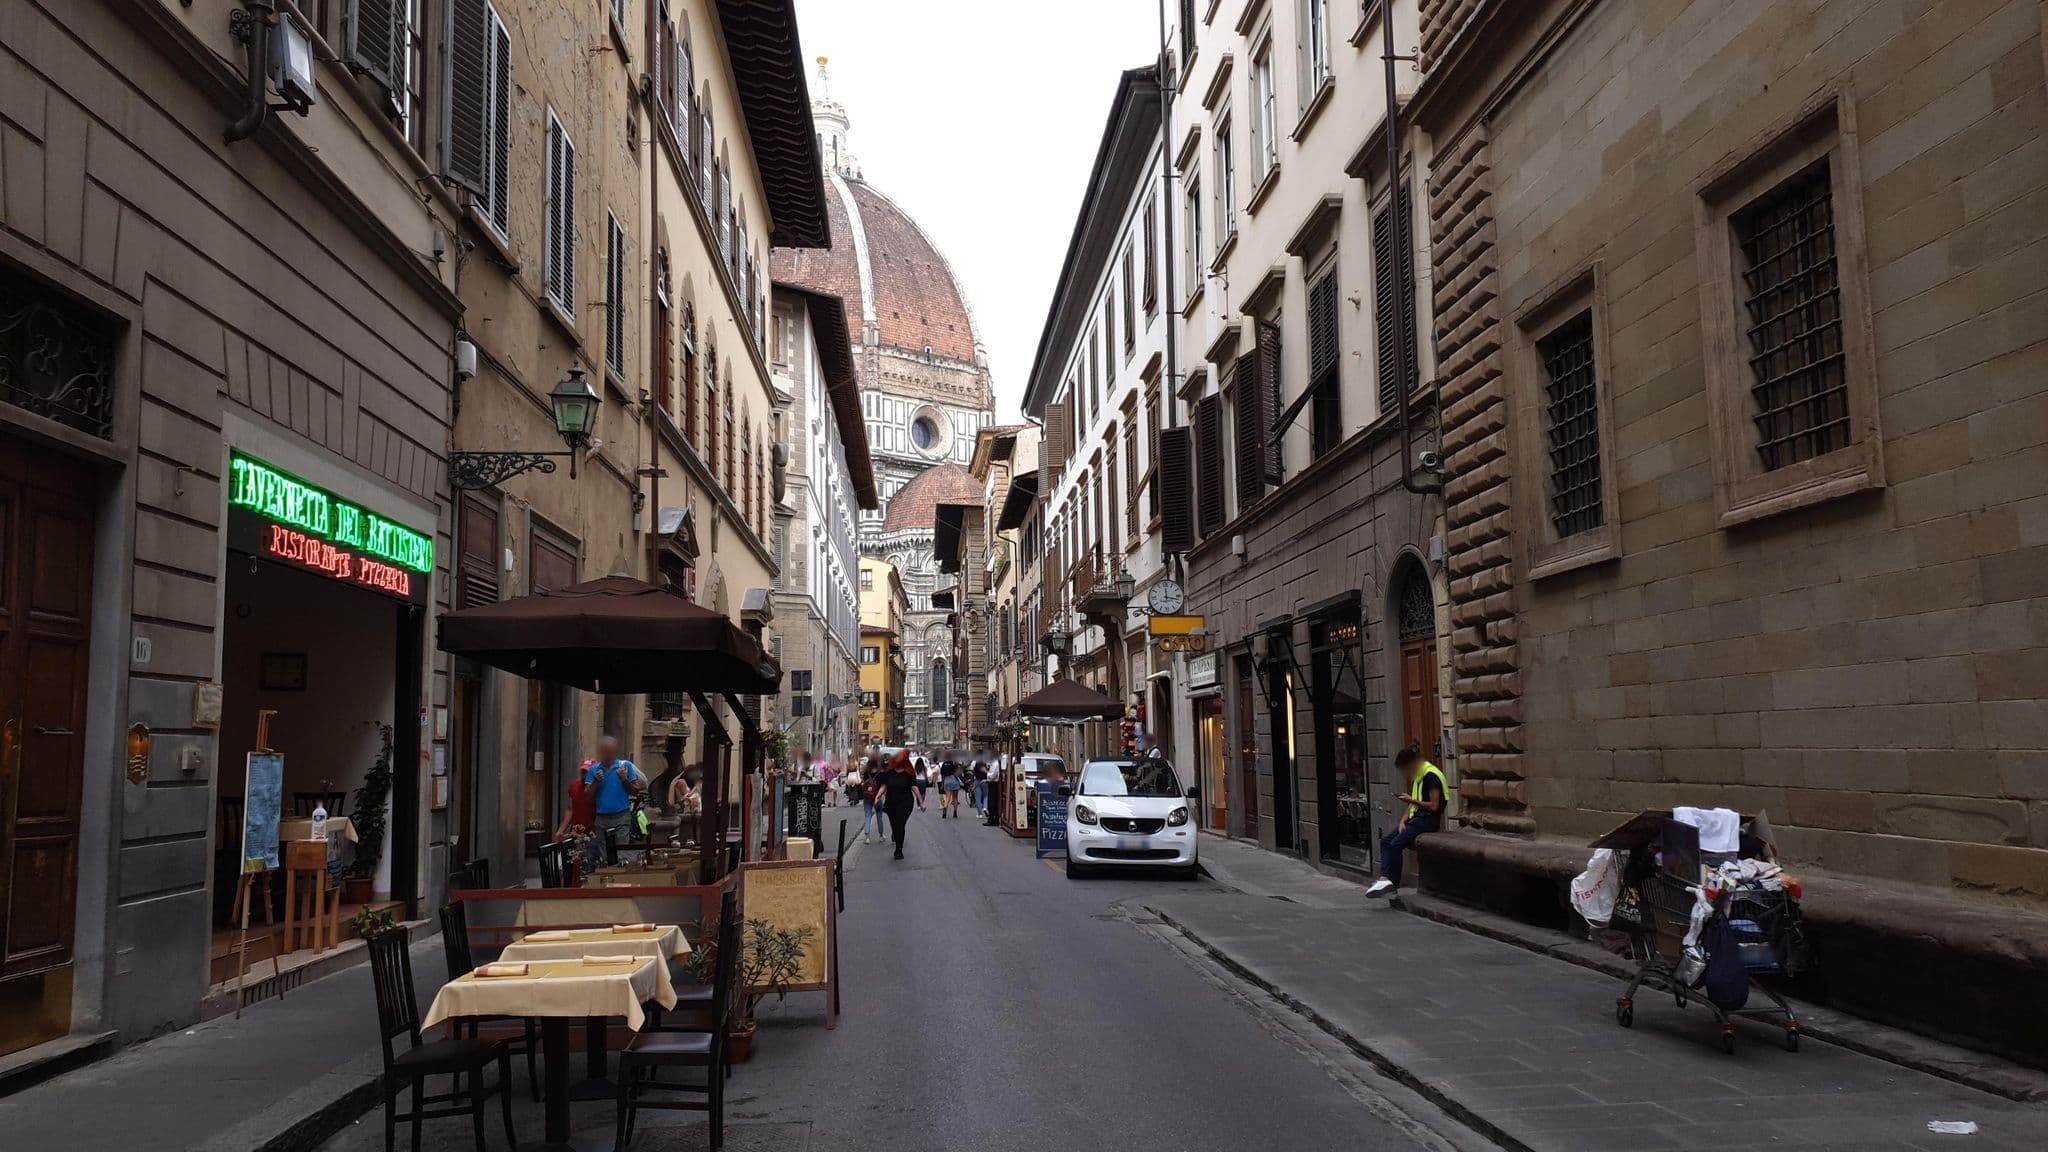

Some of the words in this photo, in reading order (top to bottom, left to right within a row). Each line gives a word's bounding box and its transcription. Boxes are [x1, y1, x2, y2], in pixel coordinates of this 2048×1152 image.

[233, 458, 329, 534] TAVERNETTA
[335, 502, 362, 546] DEL
[367, 514, 434, 573] BATTISTERO
[270, 525, 351, 578] RISTORANTE
[358, 557, 410, 596] PIZZERIA
